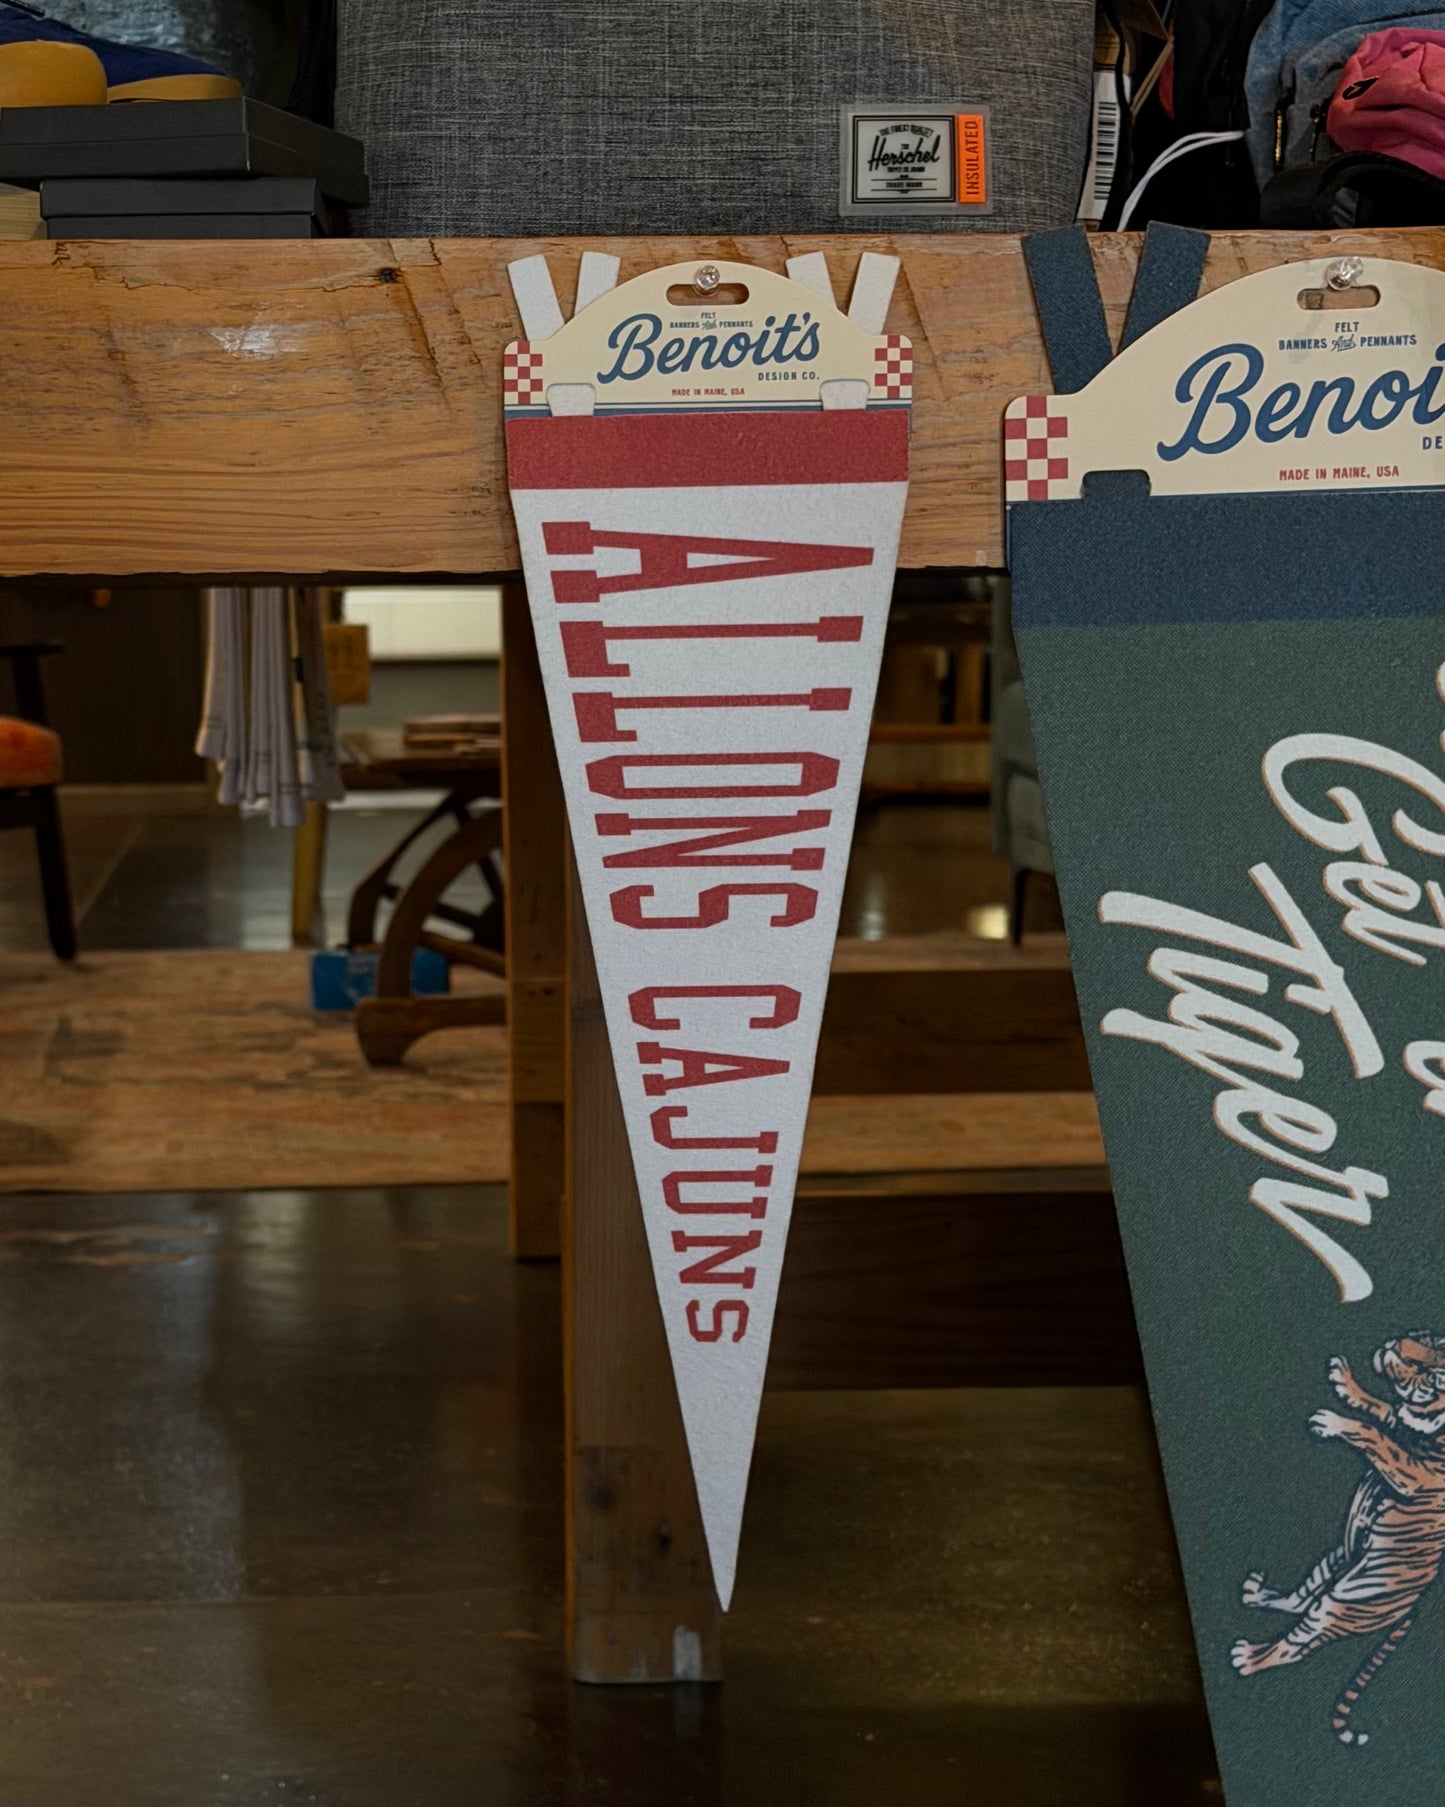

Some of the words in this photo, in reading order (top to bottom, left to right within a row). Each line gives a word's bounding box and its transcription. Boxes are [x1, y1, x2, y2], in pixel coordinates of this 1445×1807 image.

[867, 134, 941, 172] Herschel
[965, 120, 980, 195] INSULATED
[670, 321, 700, 329] BANNERS
[1335, 322, 1359, 333] FELT
[597, 311, 821, 384] Benoit's
[1279, 338, 1328, 351] BANNERS
[1360, 335, 1418, 348] PENNANTS
[758, 372, 797, 381] DESIGN
[802, 371, 820, 380] CO.
[672, 388, 690, 396] MADE
[694, 388, 702, 396] IN
[1279, 469, 1311, 481] MADE
[1316, 468, 1327, 480] IN
[1333, 466, 1371, 480] MAINE,
[1376, 465, 1400, 477] USA
[542, 522, 874, 929] ALLONS
[1099, 862, 1389, 1303] Tiger
[628, 984, 801, 1342] CAJUNS
